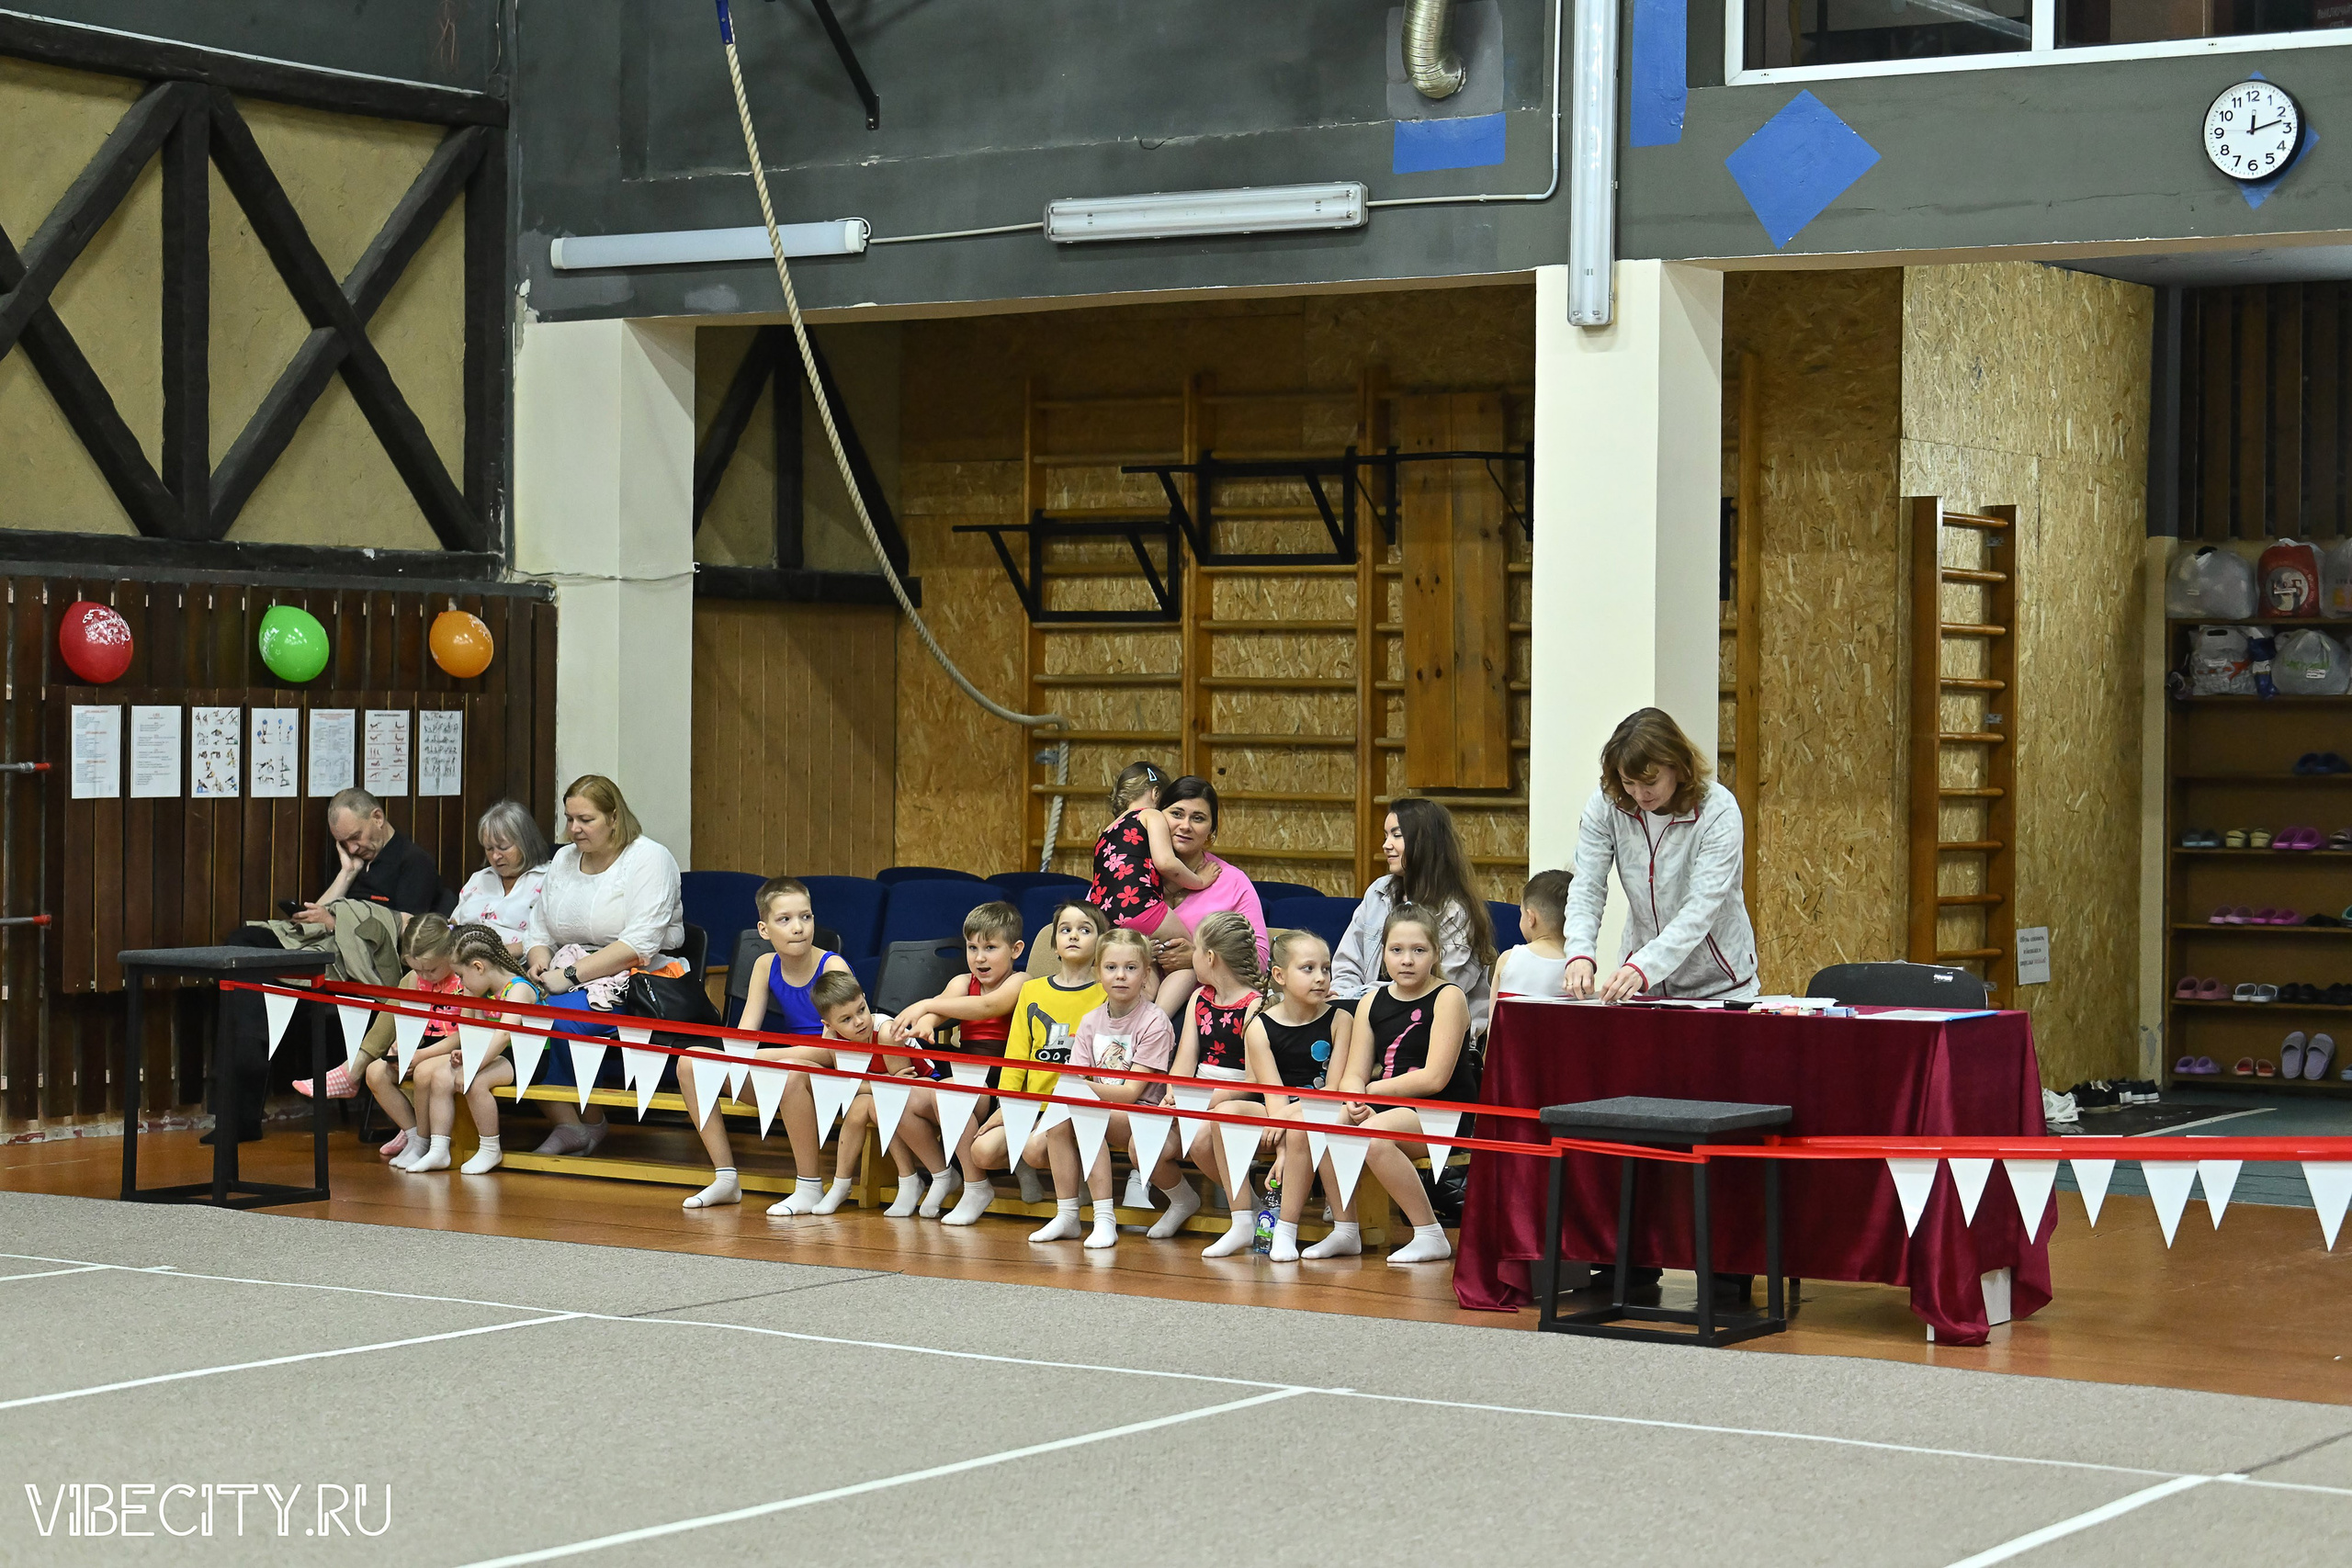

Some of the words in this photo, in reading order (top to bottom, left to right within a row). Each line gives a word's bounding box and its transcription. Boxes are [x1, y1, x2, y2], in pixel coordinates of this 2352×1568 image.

[2231, 97, 2242, 107] 11
[2245, 90, 2260, 102] 12
[2267, 95, 2273, 106] 1
[2219, 110, 2233, 121] 10
[2277, 107, 2286, 117] 2
[2213, 127, 2224, 139] 9
[2282, 122, 2292, 134] 3
[2220, 144, 2230, 156] 8
[2277, 141, 2286, 152] 4
[2233, 155, 2242, 167] 7
[2265, 152, 2275, 164] 5
[2247, 159, 2258, 172] 6
